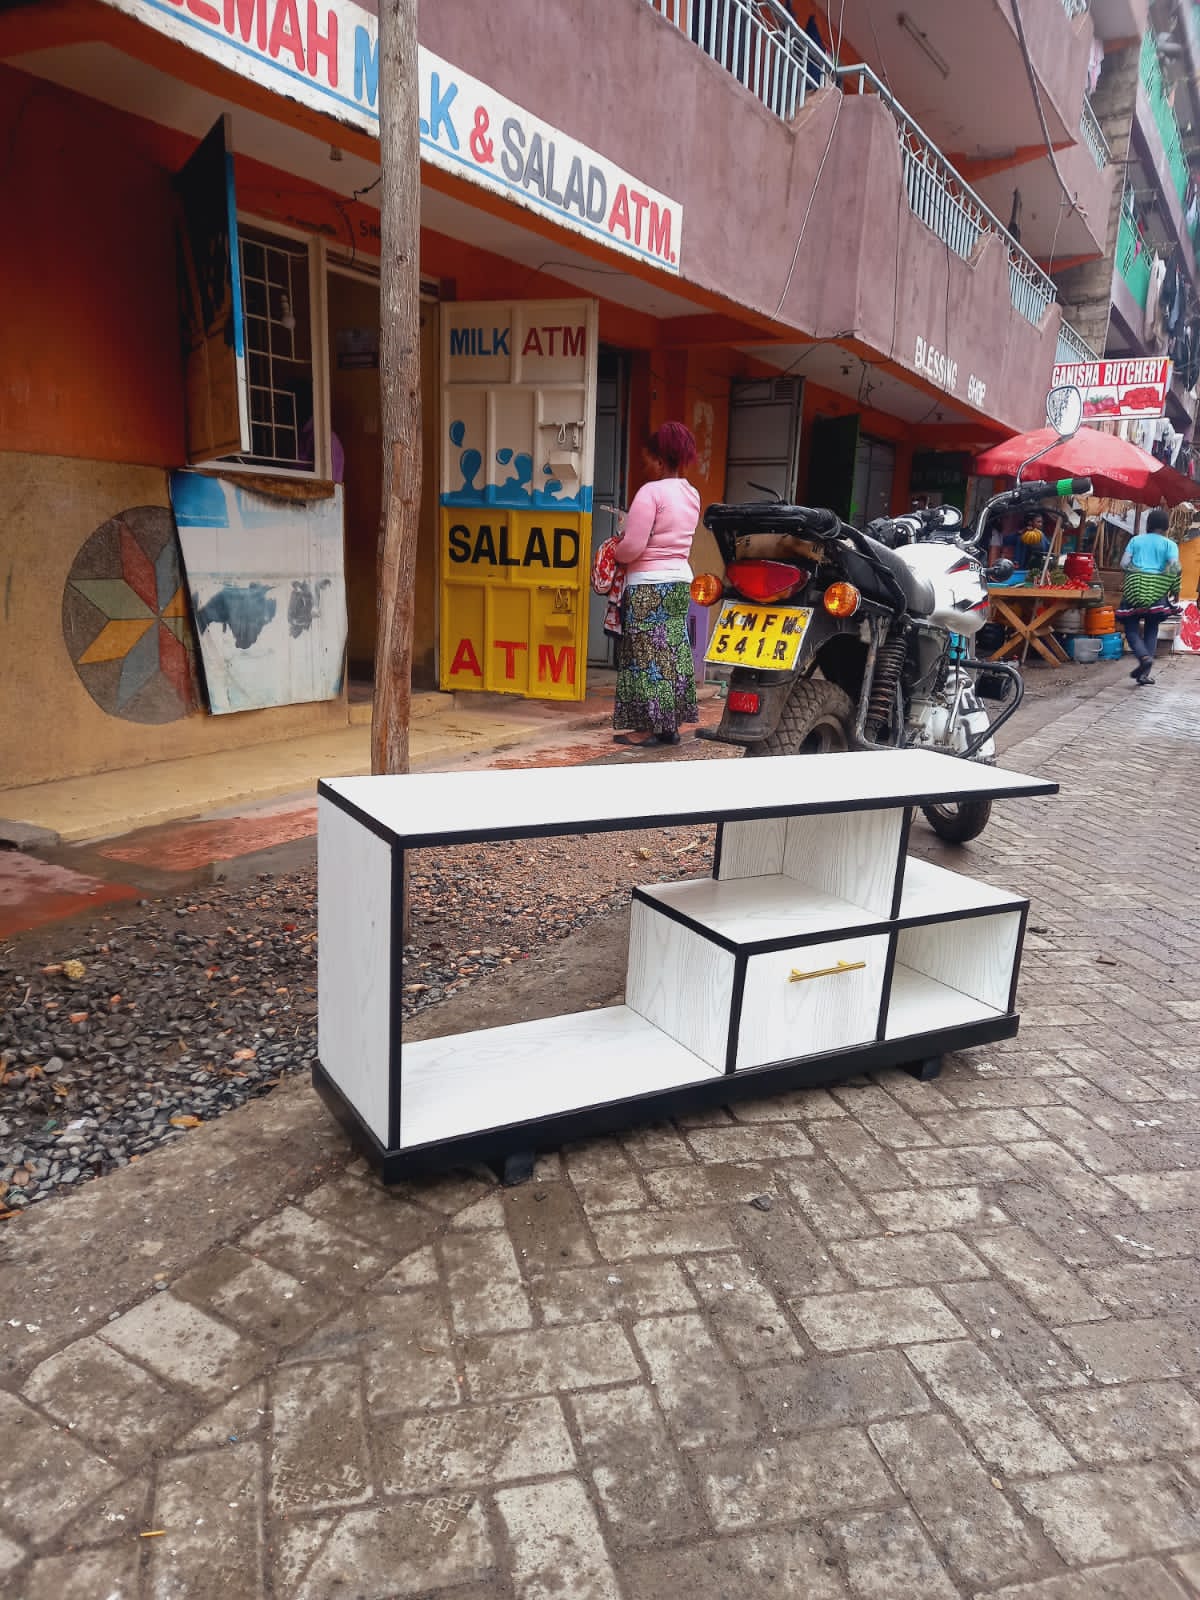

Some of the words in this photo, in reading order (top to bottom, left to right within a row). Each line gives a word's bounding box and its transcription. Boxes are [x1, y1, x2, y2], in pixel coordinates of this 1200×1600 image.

[354, 25, 459, 150] MK
[470, 106, 494, 164] &
[501, 118, 607, 223] SALAD
[608, 184, 676, 263] ATM.
[450, 328, 511, 355] MILK
[522, 326, 586, 357] ATM
[915, 336, 957, 390] BLESSING
[1103, 360, 1164, 385] BUTCHERY
[448, 524, 579, 568] SALAD
[716, 634, 787, 661] 541R
